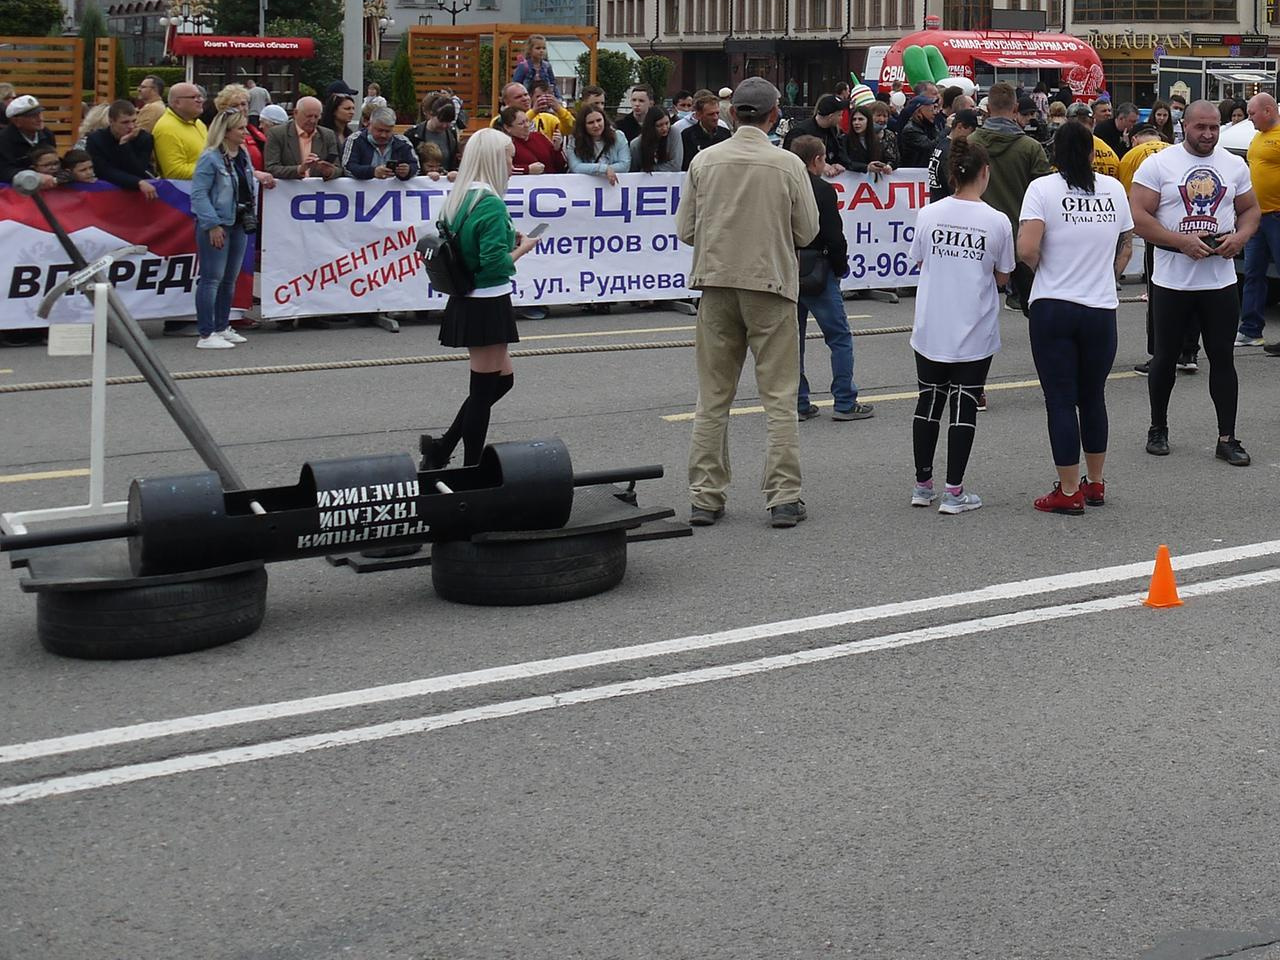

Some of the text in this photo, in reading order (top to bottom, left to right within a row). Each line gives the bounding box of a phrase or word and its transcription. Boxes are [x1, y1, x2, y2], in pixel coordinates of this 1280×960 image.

[203, 40, 299, 49] Книги Тульской области
[1088, 32, 1202, 49] RESTAURAN
[1061, 212, 1116, 225] Тулы 2021
[1180, 220, 1218, 232] НАЦИЯ
[534, 234, 642, 259] метров
[274, 225, 417, 305] СТУДЕНТАМ
[533, 276, 570, 300] ул.
[579, 270, 686, 297] Руднева
[316, 480, 420, 508] АТЛЕТИКИ
[297, 520, 431, 549] ФЕДЕРАЦИЯ
